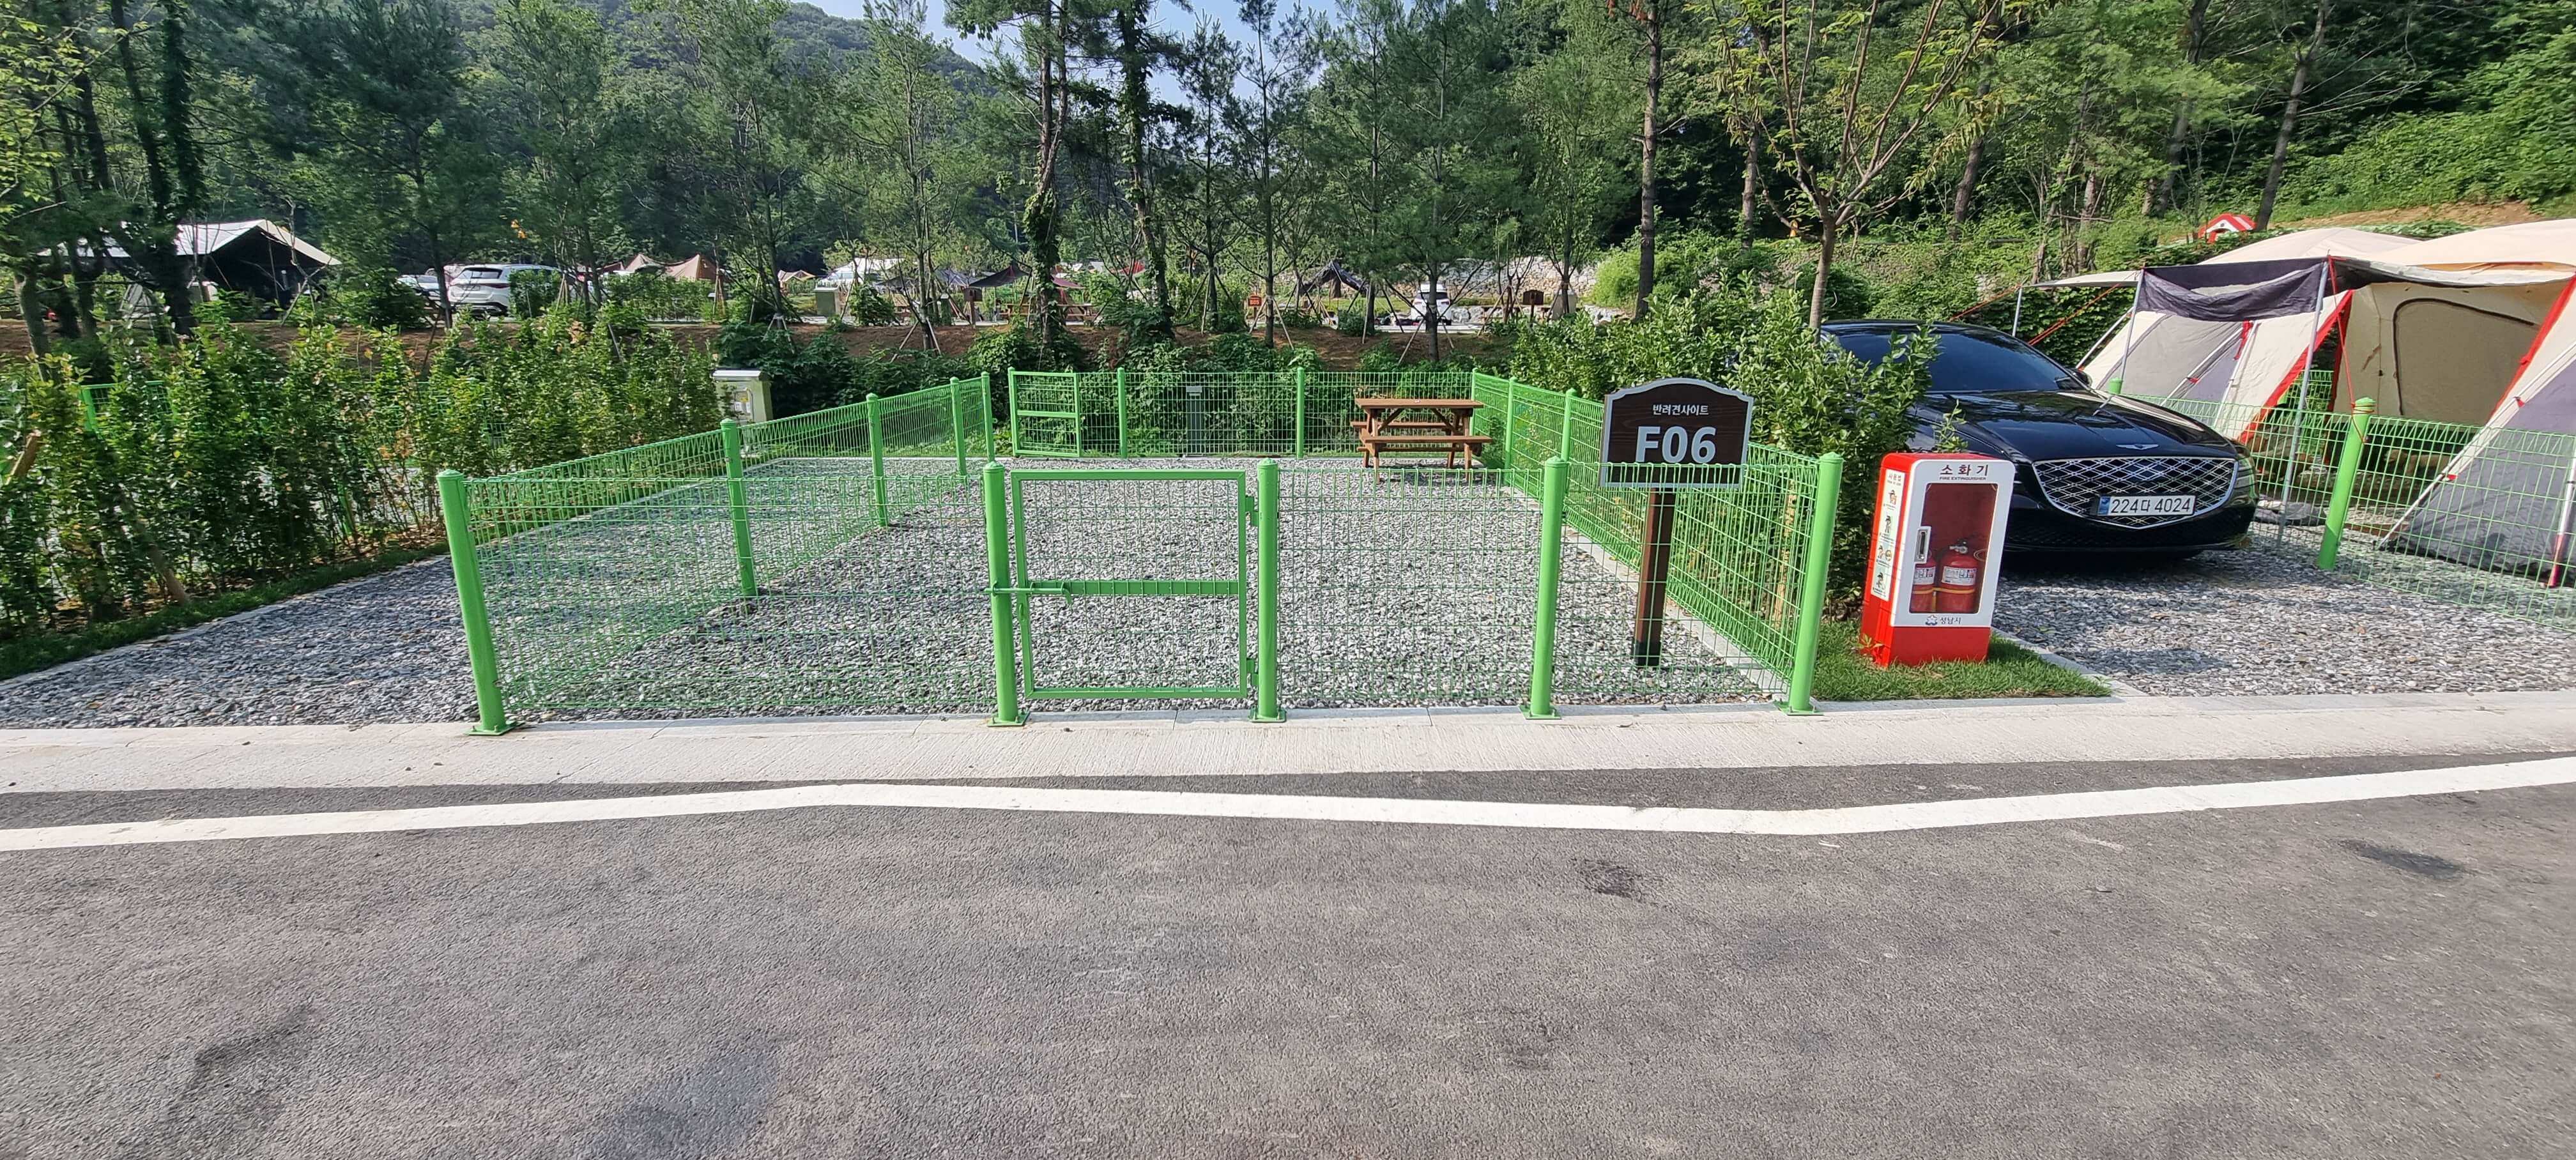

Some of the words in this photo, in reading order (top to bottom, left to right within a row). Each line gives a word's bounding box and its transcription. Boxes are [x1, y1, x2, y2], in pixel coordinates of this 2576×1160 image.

[1652, 404, 1709, 415] 반려견사이트
[1635, 425, 1717, 464] F06
[1940, 464, 1989, 476] 소화기
[2111, 499, 2150, 513] 224다
[2154, 498, 2191, 512] 4024
